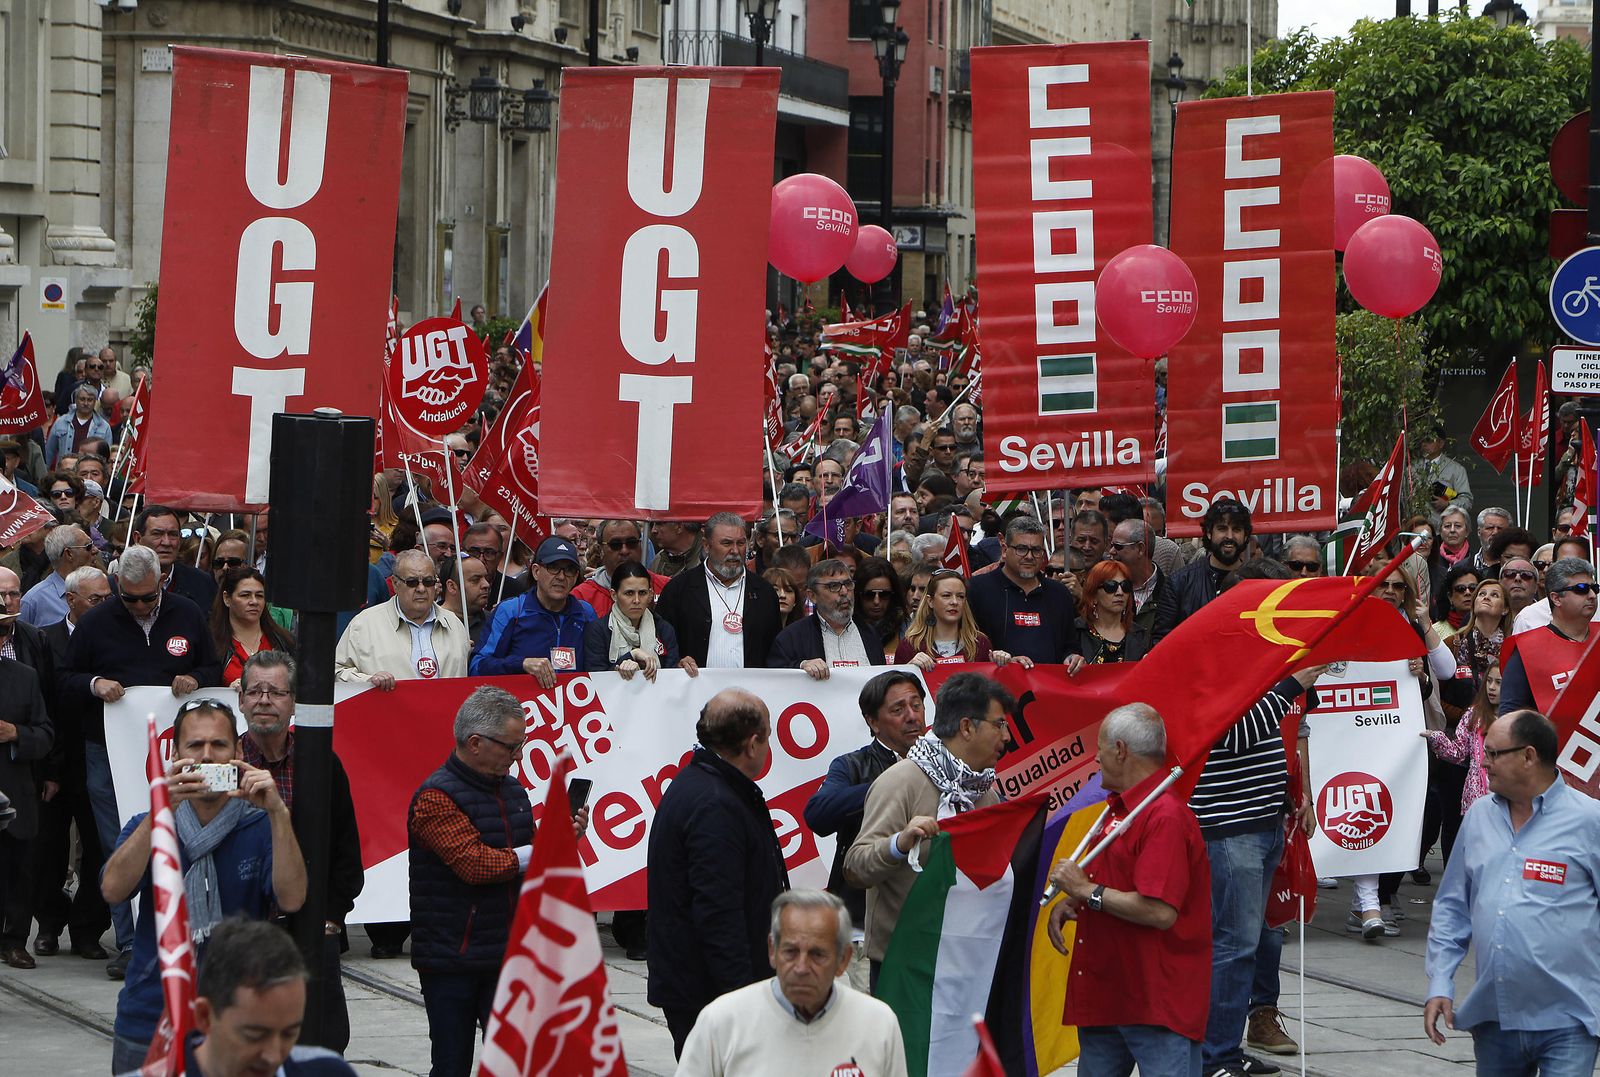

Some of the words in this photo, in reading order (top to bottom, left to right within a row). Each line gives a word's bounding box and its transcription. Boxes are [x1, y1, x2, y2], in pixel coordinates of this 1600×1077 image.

[803, 207, 852, 226] CCOO
[816, 219, 850, 236] Sevilla
[232, 64, 331, 504] UGT
[619, 77, 710, 511] UGT
[1140, 290, 1193, 303] CCOO
[1156, 303, 1191, 314] Sevilla
[401, 325, 468, 380] UGT
[1440, 365, 1487, 376] nerarios
[418, 400, 468, 422] Andalucía
[998, 430, 1142, 474] Sevilla
[726, 614, 743, 622] UGT
[168, 638, 187, 648] UGT
[418, 659, 434, 669] UGT
[555, 650, 571, 661] UGT
[523, 676, 596, 733] ayo
[1316, 687, 1371, 708] COO
[1355, 713, 1401, 727] Sevilla
[995, 736, 1085, 797] Igualdad
[1047, 779, 1082, 811] ejor
[1325, 783, 1382, 818] UGT
[1341, 838, 1374, 850] Sevilla
[1539, 871, 1563, 882] Sevilla
